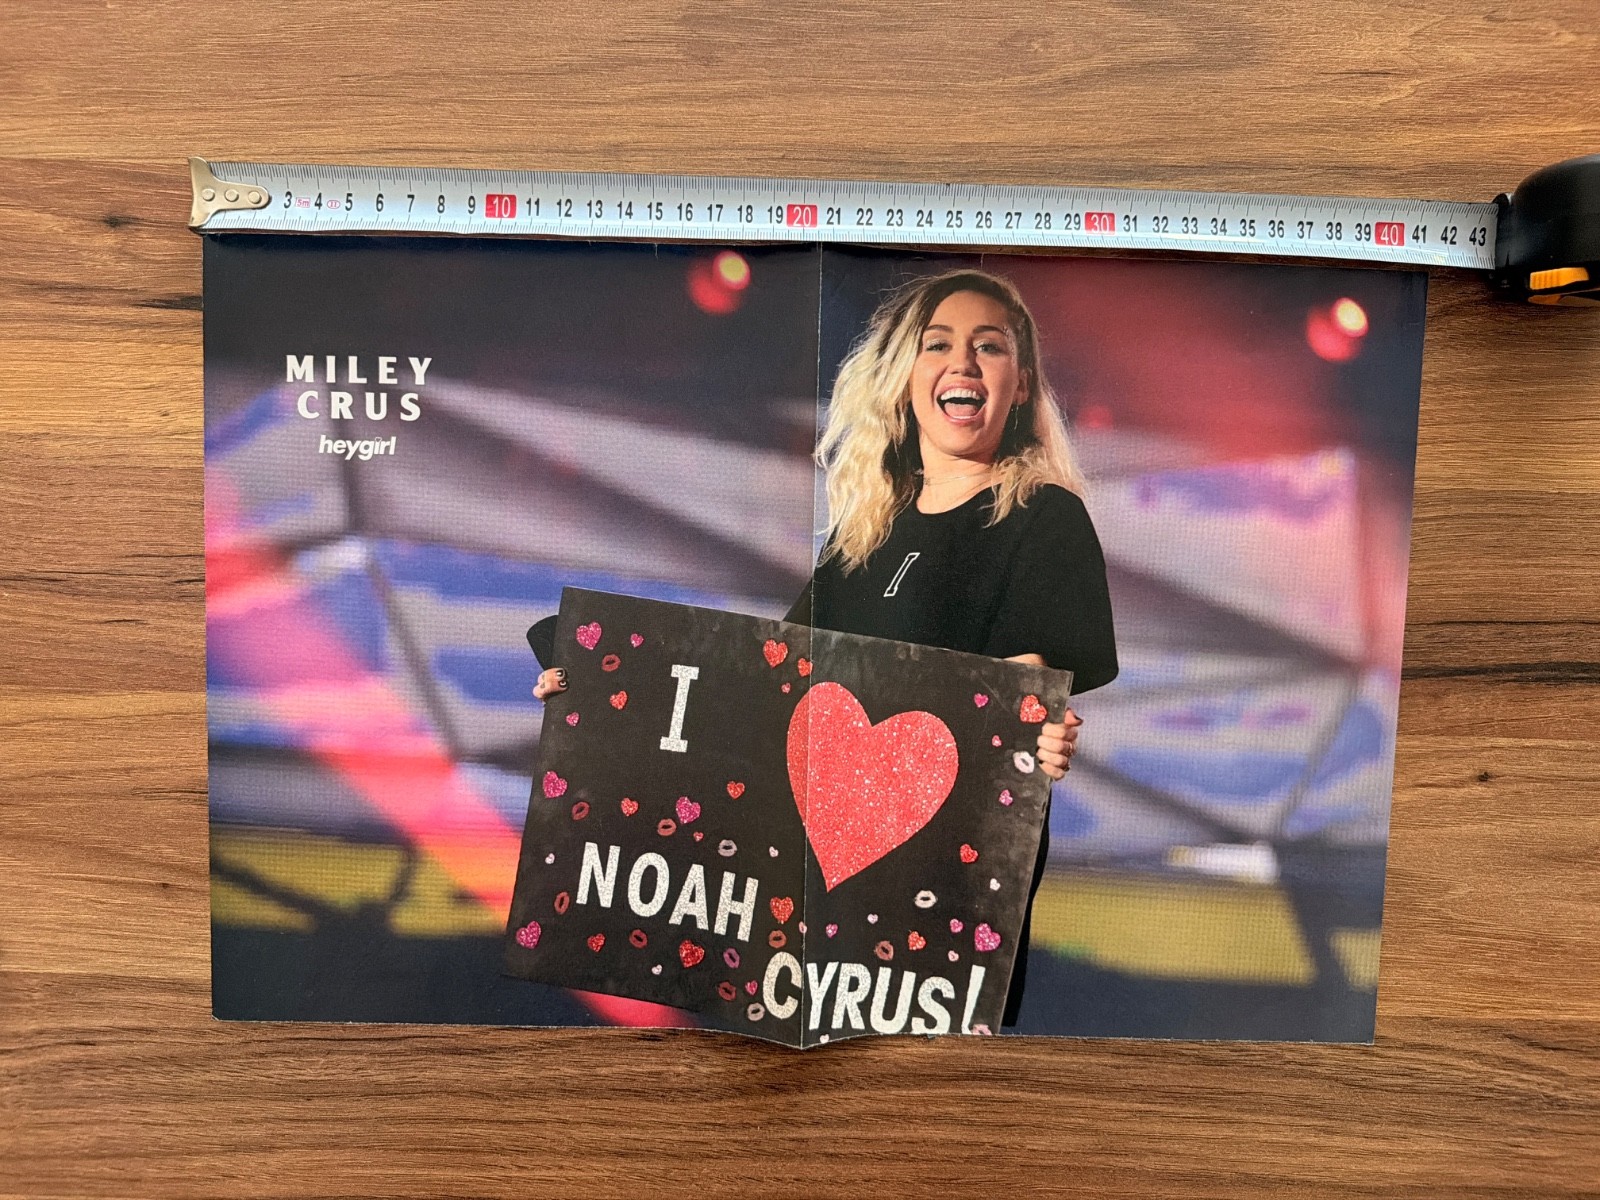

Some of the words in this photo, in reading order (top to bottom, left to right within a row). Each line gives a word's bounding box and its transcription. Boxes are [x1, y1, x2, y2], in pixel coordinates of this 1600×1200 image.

[283, 191, 292, 209] 3
[297, 199, 309, 207] 5m
[314, 192, 323, 210] 4
[345, 193, 353, 211] 5
[376, 194, 384, 211] 6
[406, 195, 415, 213] 7
[437, 195, 446, 213] 8
[468, 196, 476, 214] 9
[492, 196, 511, 217] 10
[526, 198, 540, 216] 11
[556, 198, 572, 217] 12
[587, 199, 603, 218] 13
[617, 201, 633, 220] 14
[647, 201, 663, 220] 15
[677, 203, 693, 221] 16
[707, 204, 723, 222] 17
[737, 205, 753, 223] 18
[767, 205, 783, 224] 19
[793, 206, 811, 226] 20
[826, 207, 841, 225] 21
[856, 208, 873, 226] 22
[886, 208, 904, 227] 23
[916, 209, 934, 228] 24
[946, 210, 963, 229] 25
[975, 210, 993, 229] 26
[1004, 211, 1022, 230] 27
[1034, 212, 1052, 231] 28
[1064, 213, 1081, 231] 29
[1091, 214, 1110, 232] 30
[1123, 215, 1138, 233] 31
[1152, 215, 1169, 233] 32
[1181, 217, 1198, 233] 33
[1210, 218, 1227, 235] 34
[1239, 219, 1256, 236] 35
[1268, 219, 1285, 236] 36
[1296, 221, 1313, 239] 37
[1325, 221, 1343, 240] 38
[1355, 222, 1371, 241] 39
[1380, 225, 1399, 245] 40
[1412, 225, 1427, 243] 41
[1440, 226, 1457, 245] 42
[1469, 227, 1486, 246] 43
[286, 355, 432, 385] MILEY
[298, 391, 421, 421] CRUS
[318, 435, 396, 461] heygirl
[659, 664, 699, 753] I
[576, 842, 759, 942] NOAH
[763, 951, 986, 1035] CYRUS!
